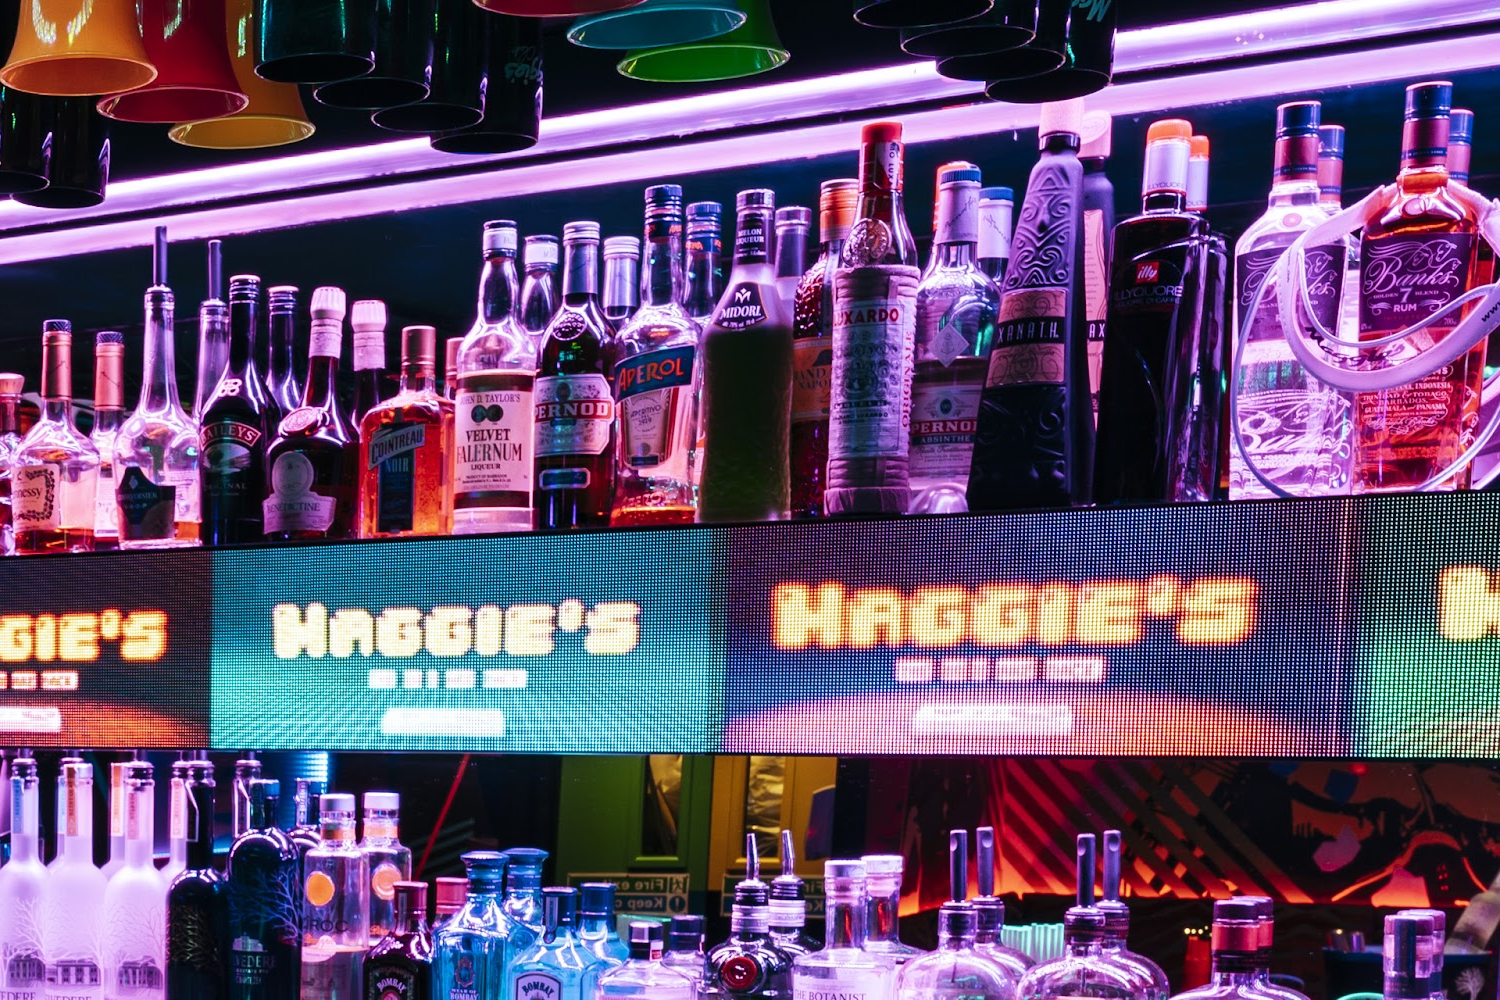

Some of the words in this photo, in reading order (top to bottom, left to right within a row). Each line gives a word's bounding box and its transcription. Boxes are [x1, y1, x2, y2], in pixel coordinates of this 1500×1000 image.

[735, 236, 765, 245] LIQUEUR
[737, 228, 762, 237] MELON
[1136, 265, 1158, 280] illy
[1363, 256, 1458, 294] Banks
[1400, 288, 1412, 303] 7
[1393, 303, 1417, 312] RUM
[617, 357, 685, 390] APEROL
[485, 393, 521, 404] TAYLOR'S
[534, 401, 611, 420] PERNOD
[202, 422, 257, 445] BAILEYS
[466, 428, 510, 442] VELVET
[920, 435, 972, 443] ABSINTHE
[369, 428, 425, 463] COINTREAU
[457, 442, 523, 463] FALERNUM
[771, 572, 1260, 650] MAGGIE'S
[271, 598, 641, 659] MAGGIE'S
[376, 977, 407, 994] BOMBAY
[521, 981, 555, 999] BOMBAY
